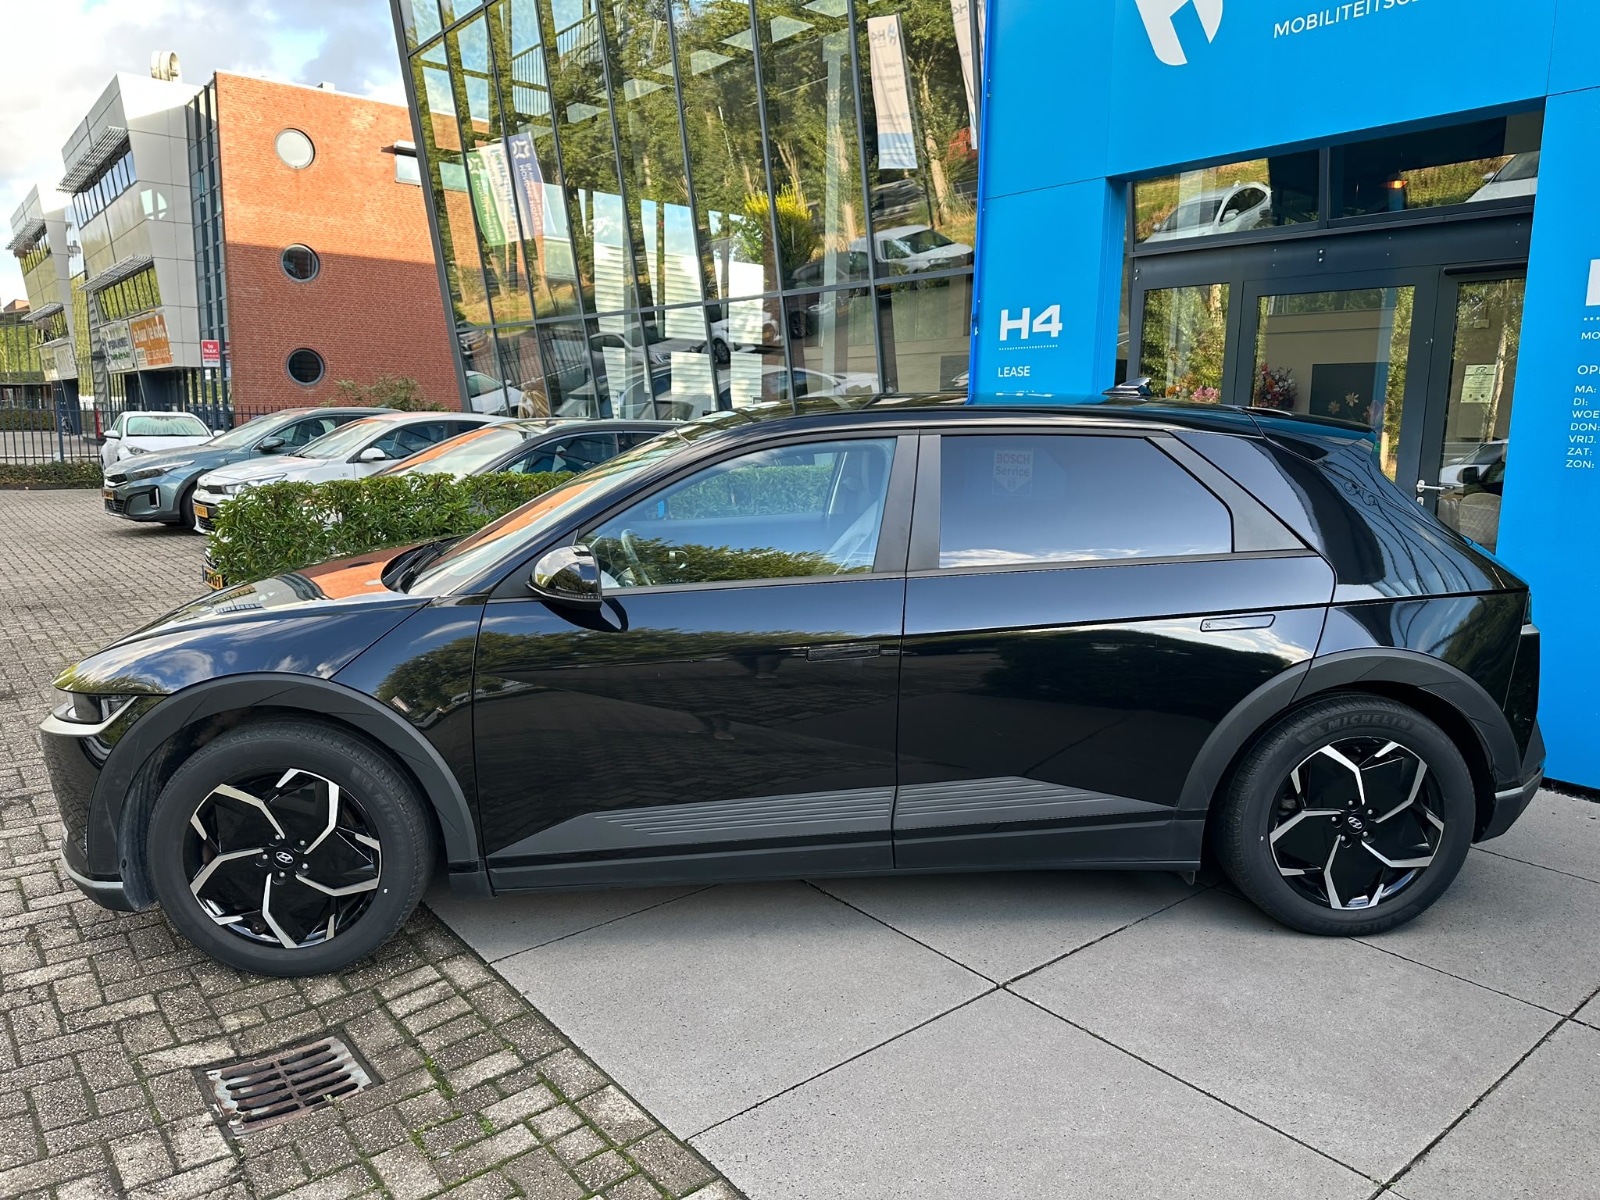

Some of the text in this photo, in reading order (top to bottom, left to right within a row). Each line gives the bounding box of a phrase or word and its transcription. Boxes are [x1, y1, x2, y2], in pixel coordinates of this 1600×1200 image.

[999, 304, 1063, 341] H4
[998, 366, 1031, 378] LEASE
[1577, 364, 1600, 375] OP
[1574, 385, 1597, 394] MA:
[1573, 397, 1589, 406] DI:
[1567, 447, 1593, 456] ZAT:
[996, 453, 1031, 465] BOSCH
[1565, 459, 1595, 469] ZON:
[995, 465, 1030, 477] Service
[1328, 714, 1411, 732] MICHELIN
